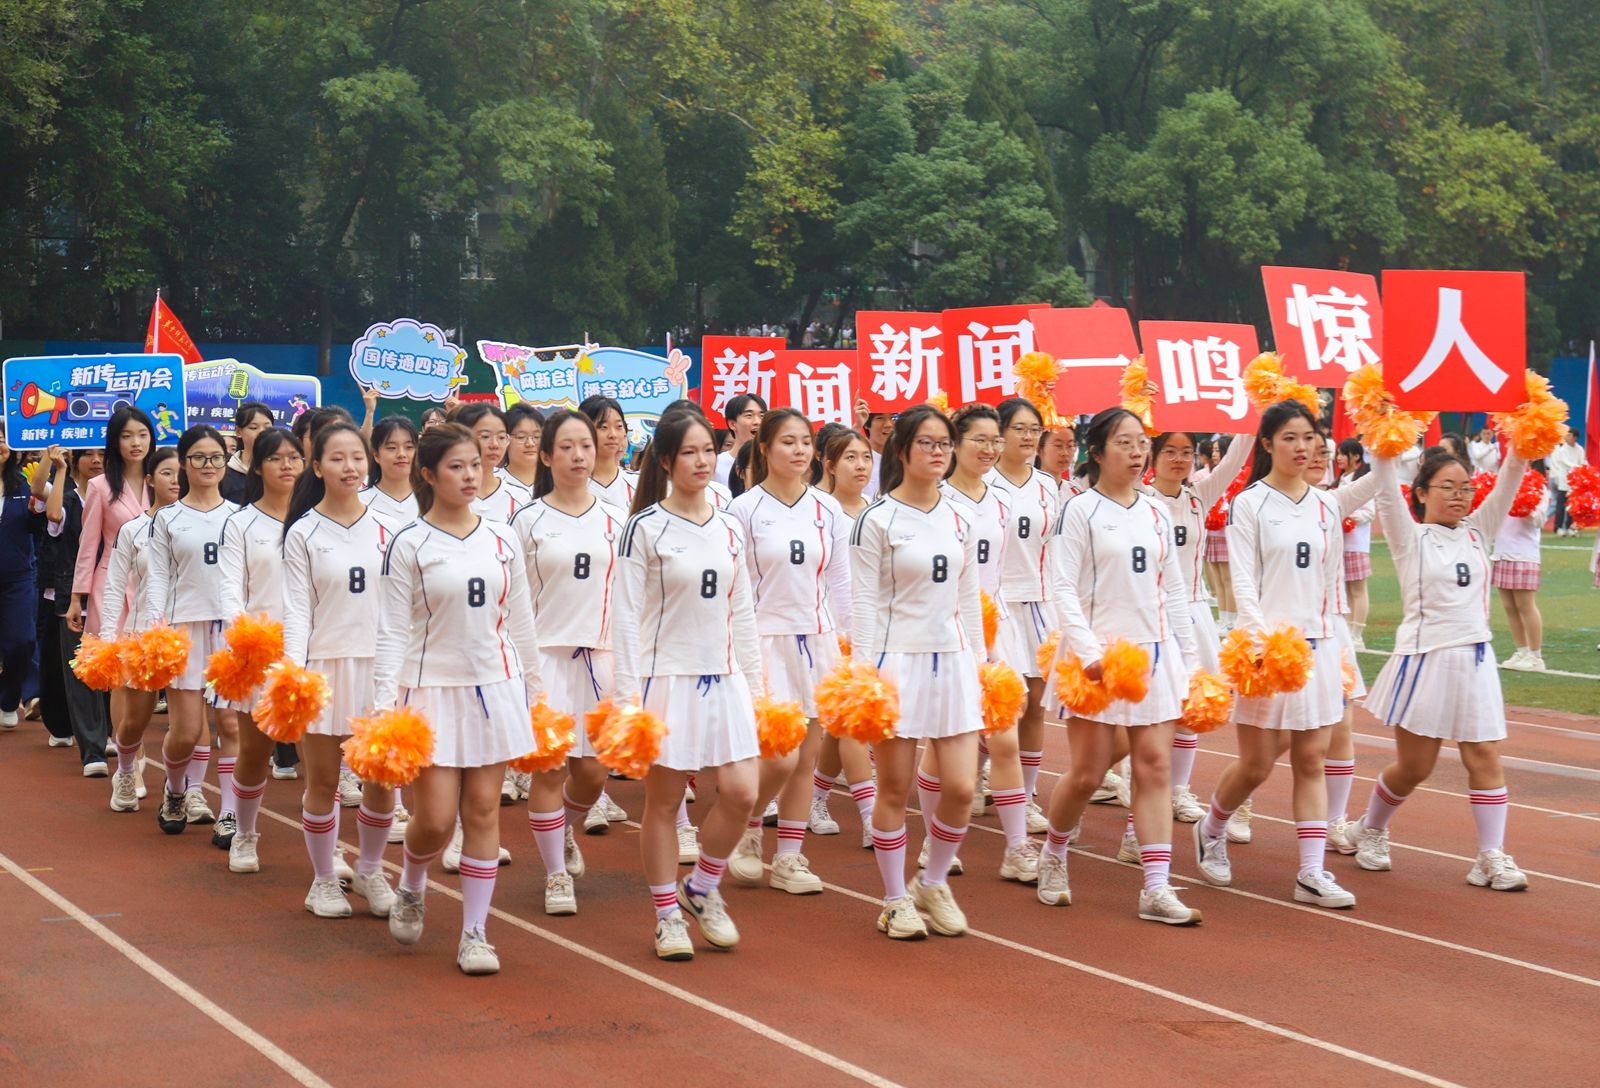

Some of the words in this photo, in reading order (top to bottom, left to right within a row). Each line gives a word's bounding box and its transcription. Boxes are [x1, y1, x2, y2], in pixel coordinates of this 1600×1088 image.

[1286, 284, 1380, 372] 惊
[1399, 287, 1510, 394] 人
[363, 347, 449, 378] 国传通四海
[869, 323, 944, 401] 新
[958, 318, 1035, 403] 闻
[1058, 353, 1130, 367] 一
[70, 363, 173, 398] 新传运动会
[711, 347, 776, 418] 新
[1156, 335, 1248, 420] 鸣
[788, 362, 852, 427] 闻
[1018, 516, 1031, 538] 8
[1173, 525, 1188, 546] 8
[203, 541, 219, 565] 8
[573, 552, 591, 579] 8
[790, 540, 805, 564] 8
[977, 539, 990, 563] 8
[1132, 546, 1147, 573] 8
[1295, 541, 1311, 568] 8
[348, 566, 366, 593] 8
[931, 554, 948, 583] 8
[1456, 562, 1471, 587] 8
[467, 577, 486, 607] 8
[700, 569, 718, 598] 8
